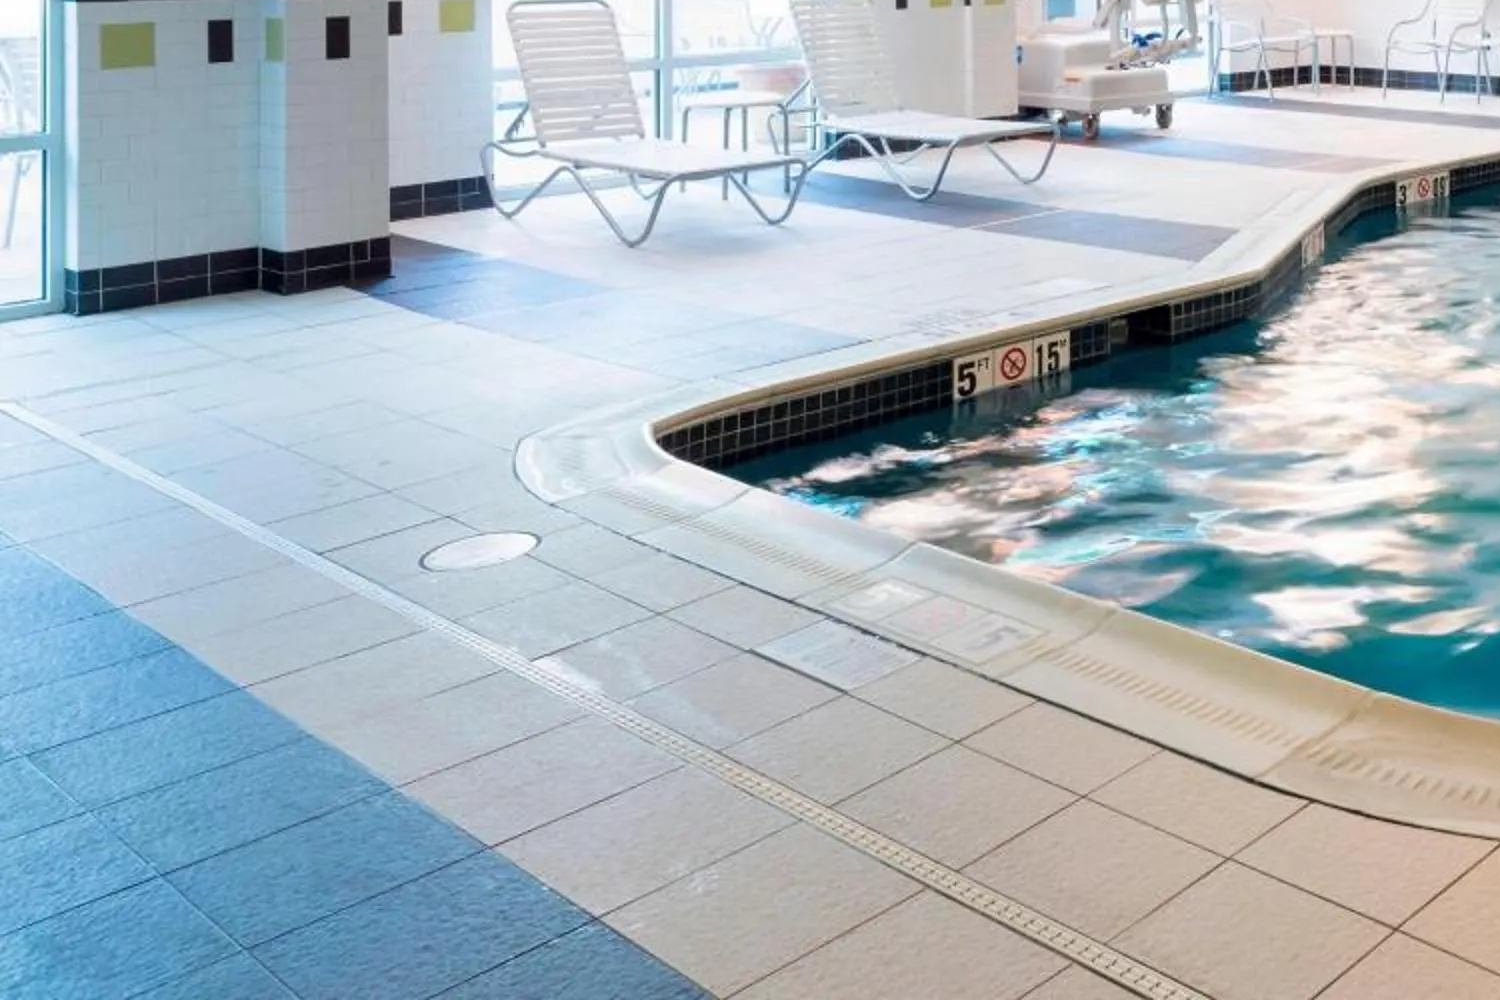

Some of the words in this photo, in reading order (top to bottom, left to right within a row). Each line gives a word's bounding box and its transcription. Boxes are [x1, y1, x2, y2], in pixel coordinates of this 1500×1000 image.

[1399, 184, 1407, 204] 3
[957, 361, 977, 397] 5
[978, 357, 990, 372] FT
[1036, 340, 1060, 377] 15
